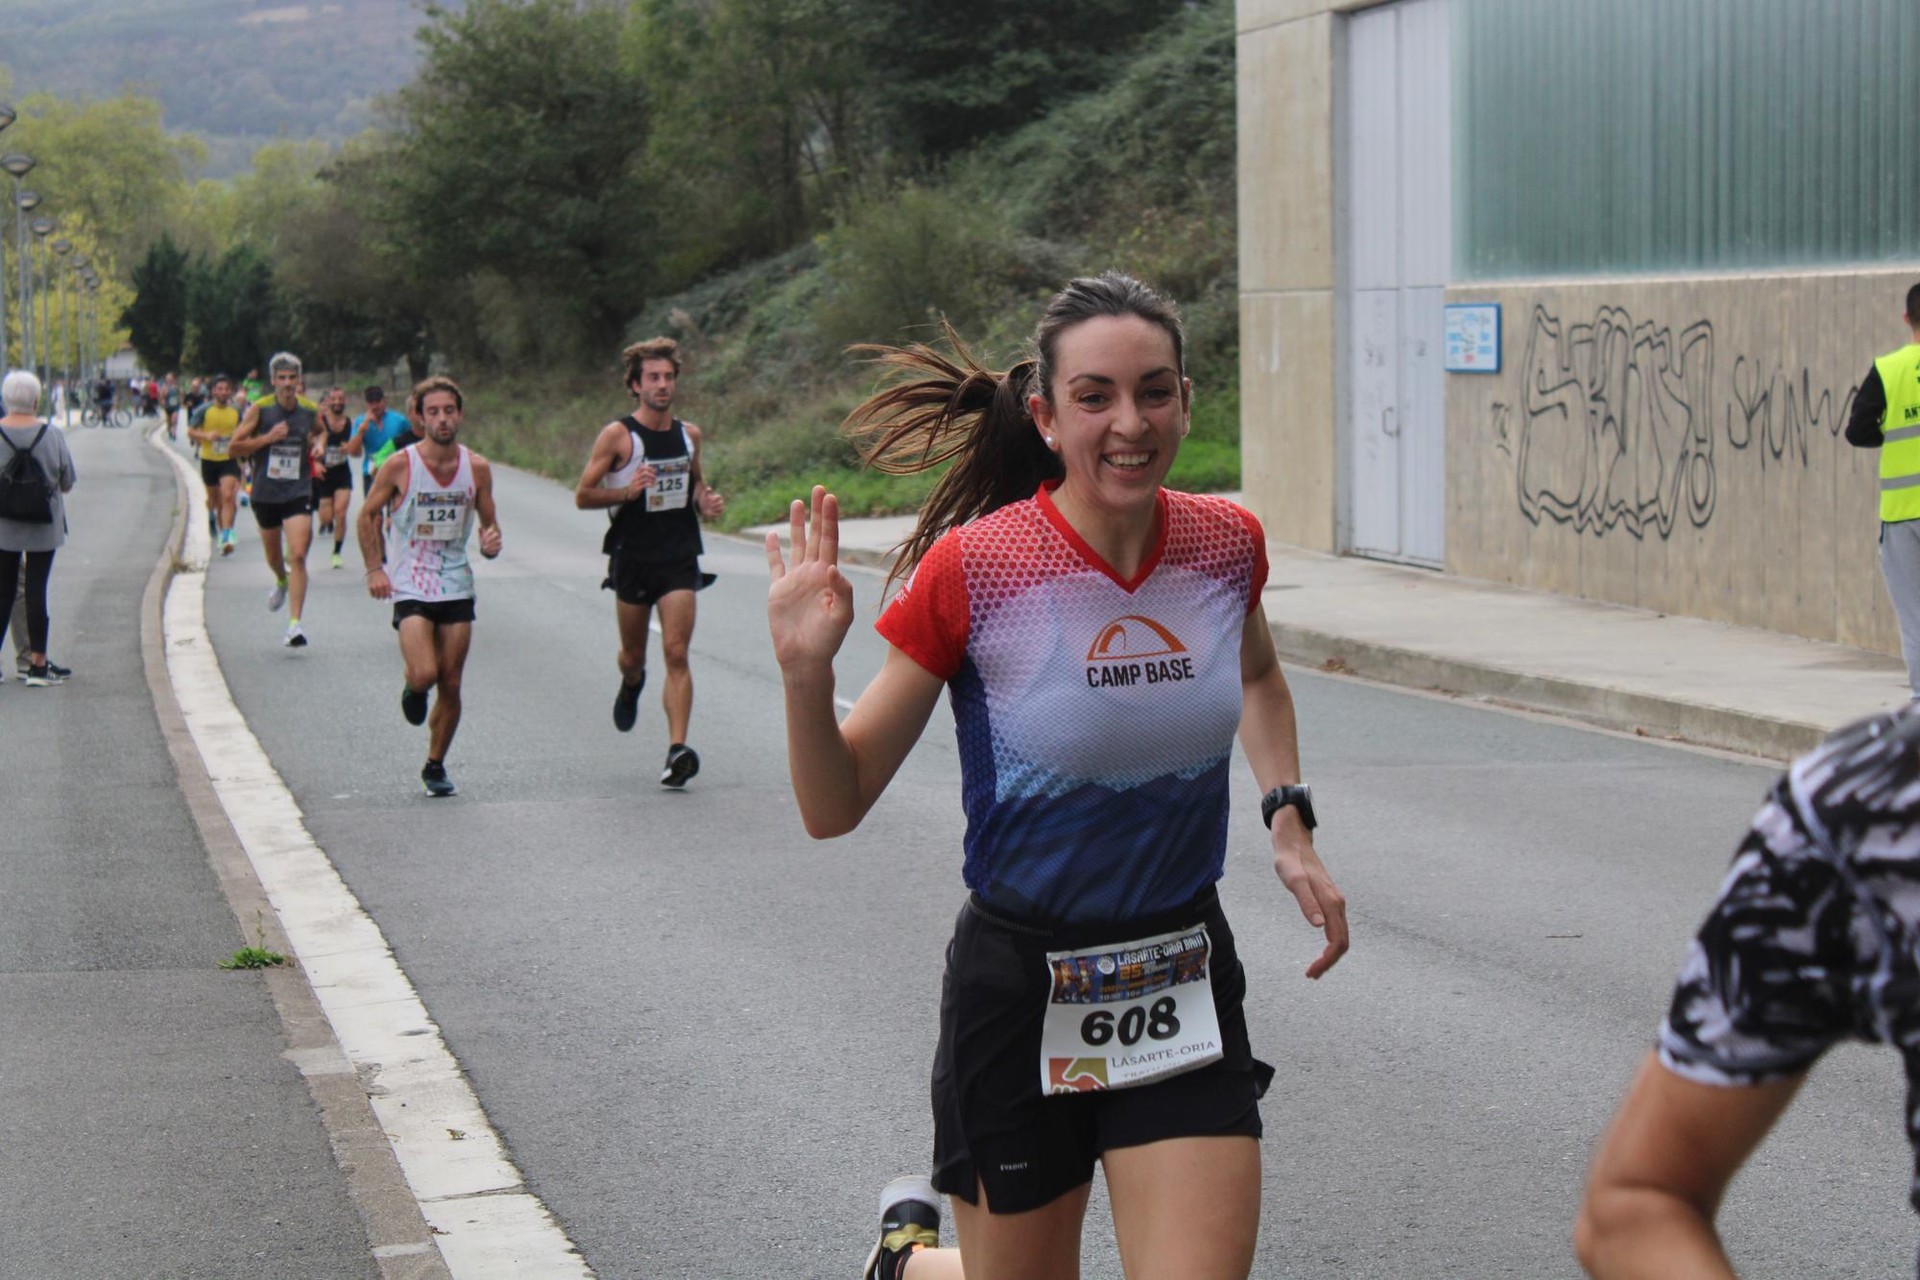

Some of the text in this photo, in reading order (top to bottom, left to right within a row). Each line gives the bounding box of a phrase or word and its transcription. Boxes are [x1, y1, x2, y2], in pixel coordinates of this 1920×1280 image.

[656, 478, 683, 492] 125
[427, 509, 456, 521] 124
[1087, 658, 1195, 687] CAMP BASE
[1080, 996, 1181, 1047] 608
[1111, 1040, 1216, 1068] LASARTE-ORIA
